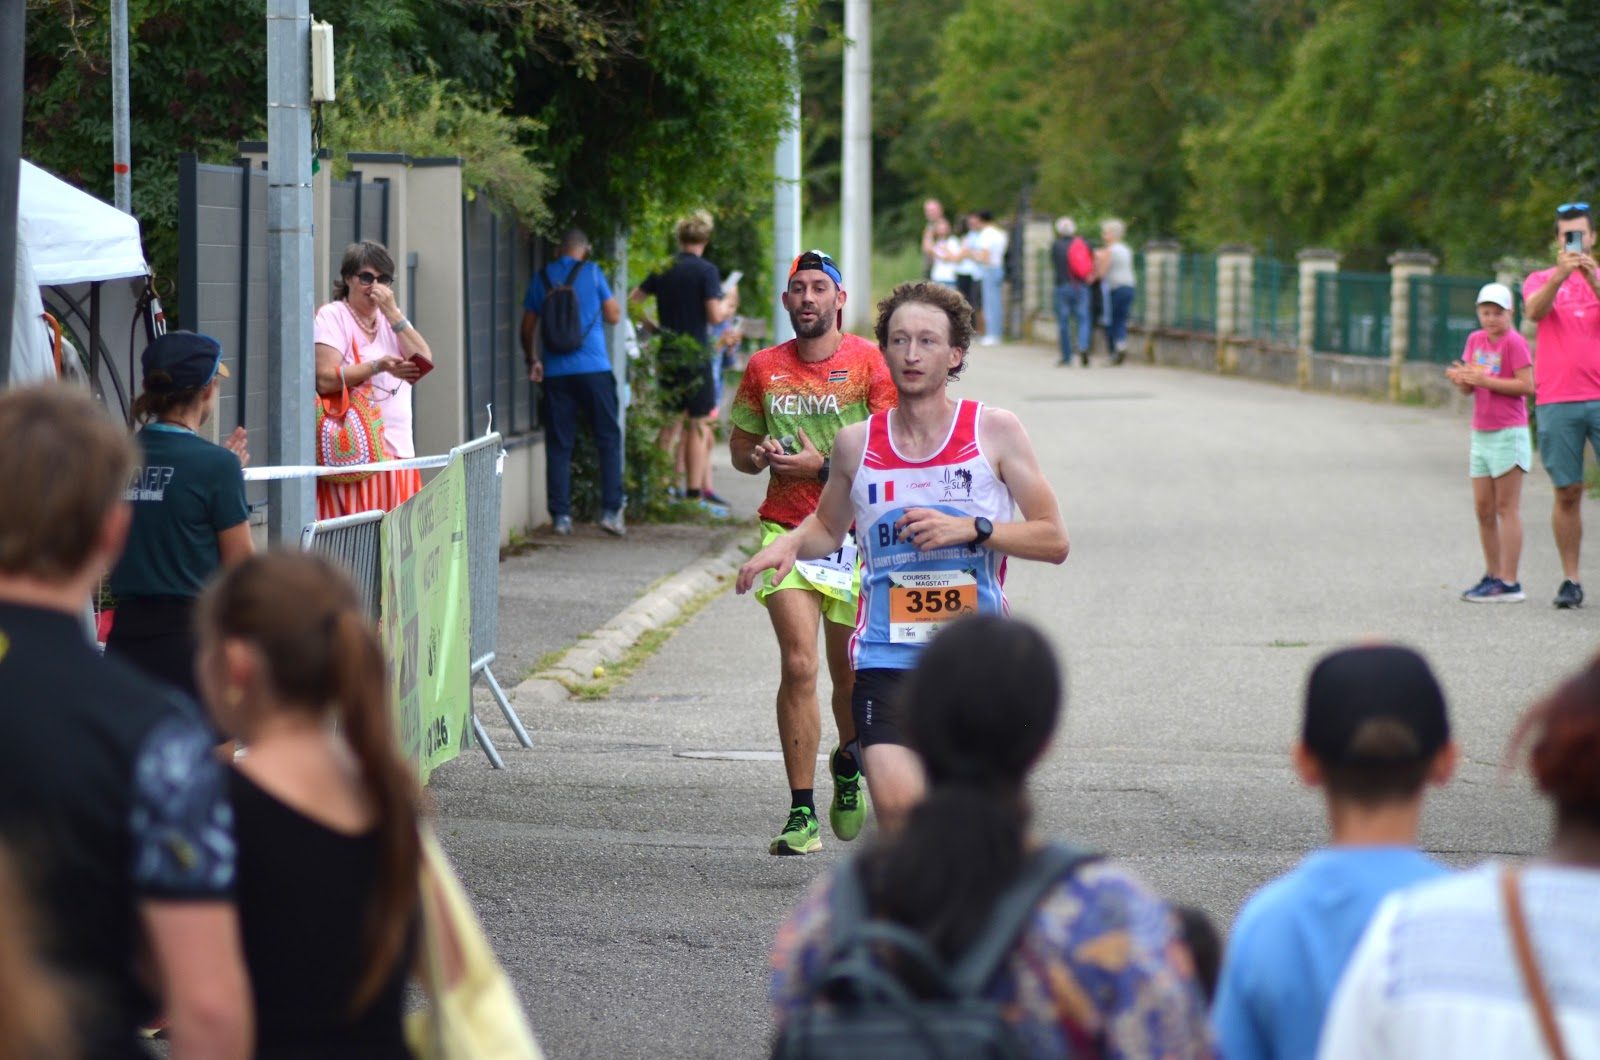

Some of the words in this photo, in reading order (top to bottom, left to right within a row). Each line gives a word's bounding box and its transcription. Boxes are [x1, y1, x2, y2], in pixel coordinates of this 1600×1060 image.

[770, 394, 840, 415] KENYA
[127, 466, 175, 491] AFF
[873, 554, 892, 568] SAINT
[892, 551, 916, 564] LOUIS
[918, 548, 961, 562] RUNNING
[906, 589, 962, 613] 358
